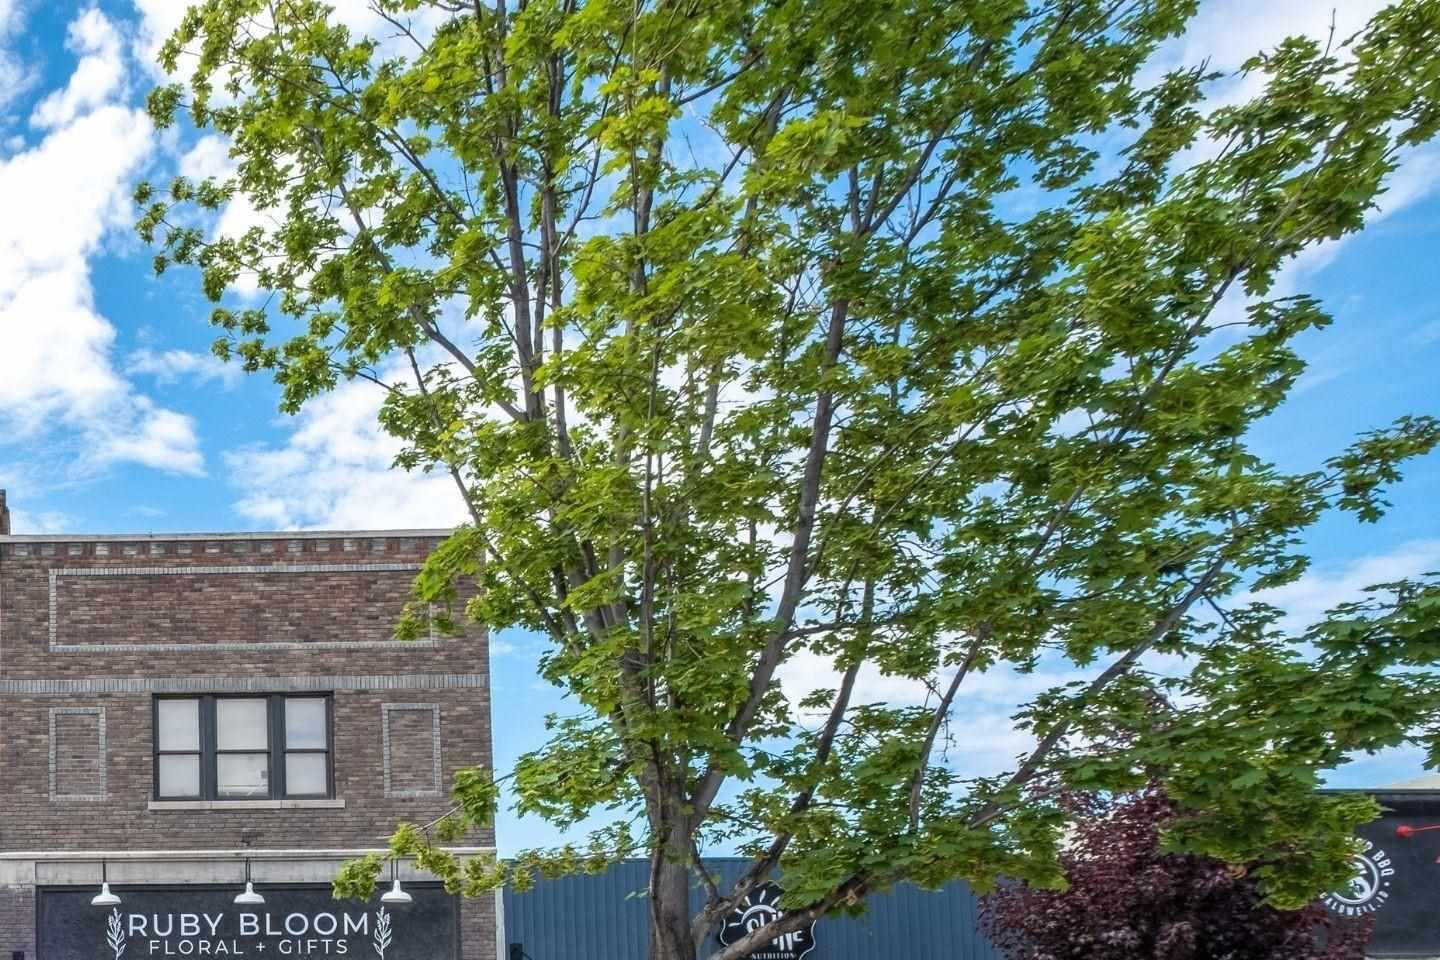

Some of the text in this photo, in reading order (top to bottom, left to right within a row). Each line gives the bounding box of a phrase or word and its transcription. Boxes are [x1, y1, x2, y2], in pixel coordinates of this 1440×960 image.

[1372, 851, 1394, 877] BBQ
[128, 912, 369, 937] RUBY BLOOM
[149, 939, 245, 955] FLORAL
[278, 938, 349, 955] GIFTS
[751, 952, 795, 960] NUTRITION
